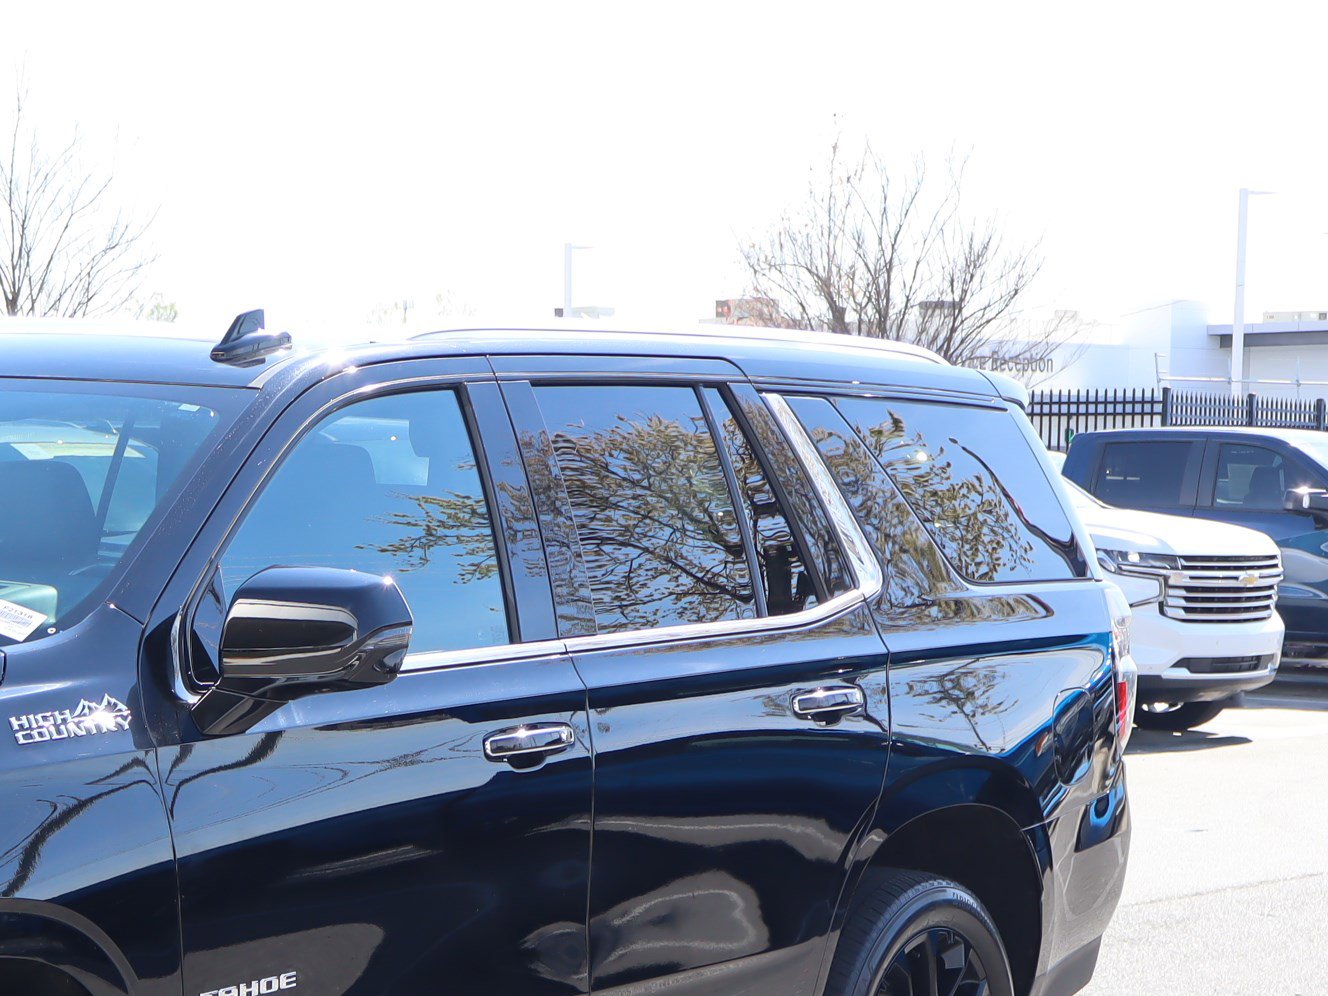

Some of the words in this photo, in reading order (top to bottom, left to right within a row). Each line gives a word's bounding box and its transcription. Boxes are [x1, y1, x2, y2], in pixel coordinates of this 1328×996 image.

[990, 351, 1054, 376] Reception
[9, 709, 72, 731] HIGH
[14, 715, 132, 745] COUNTRY
